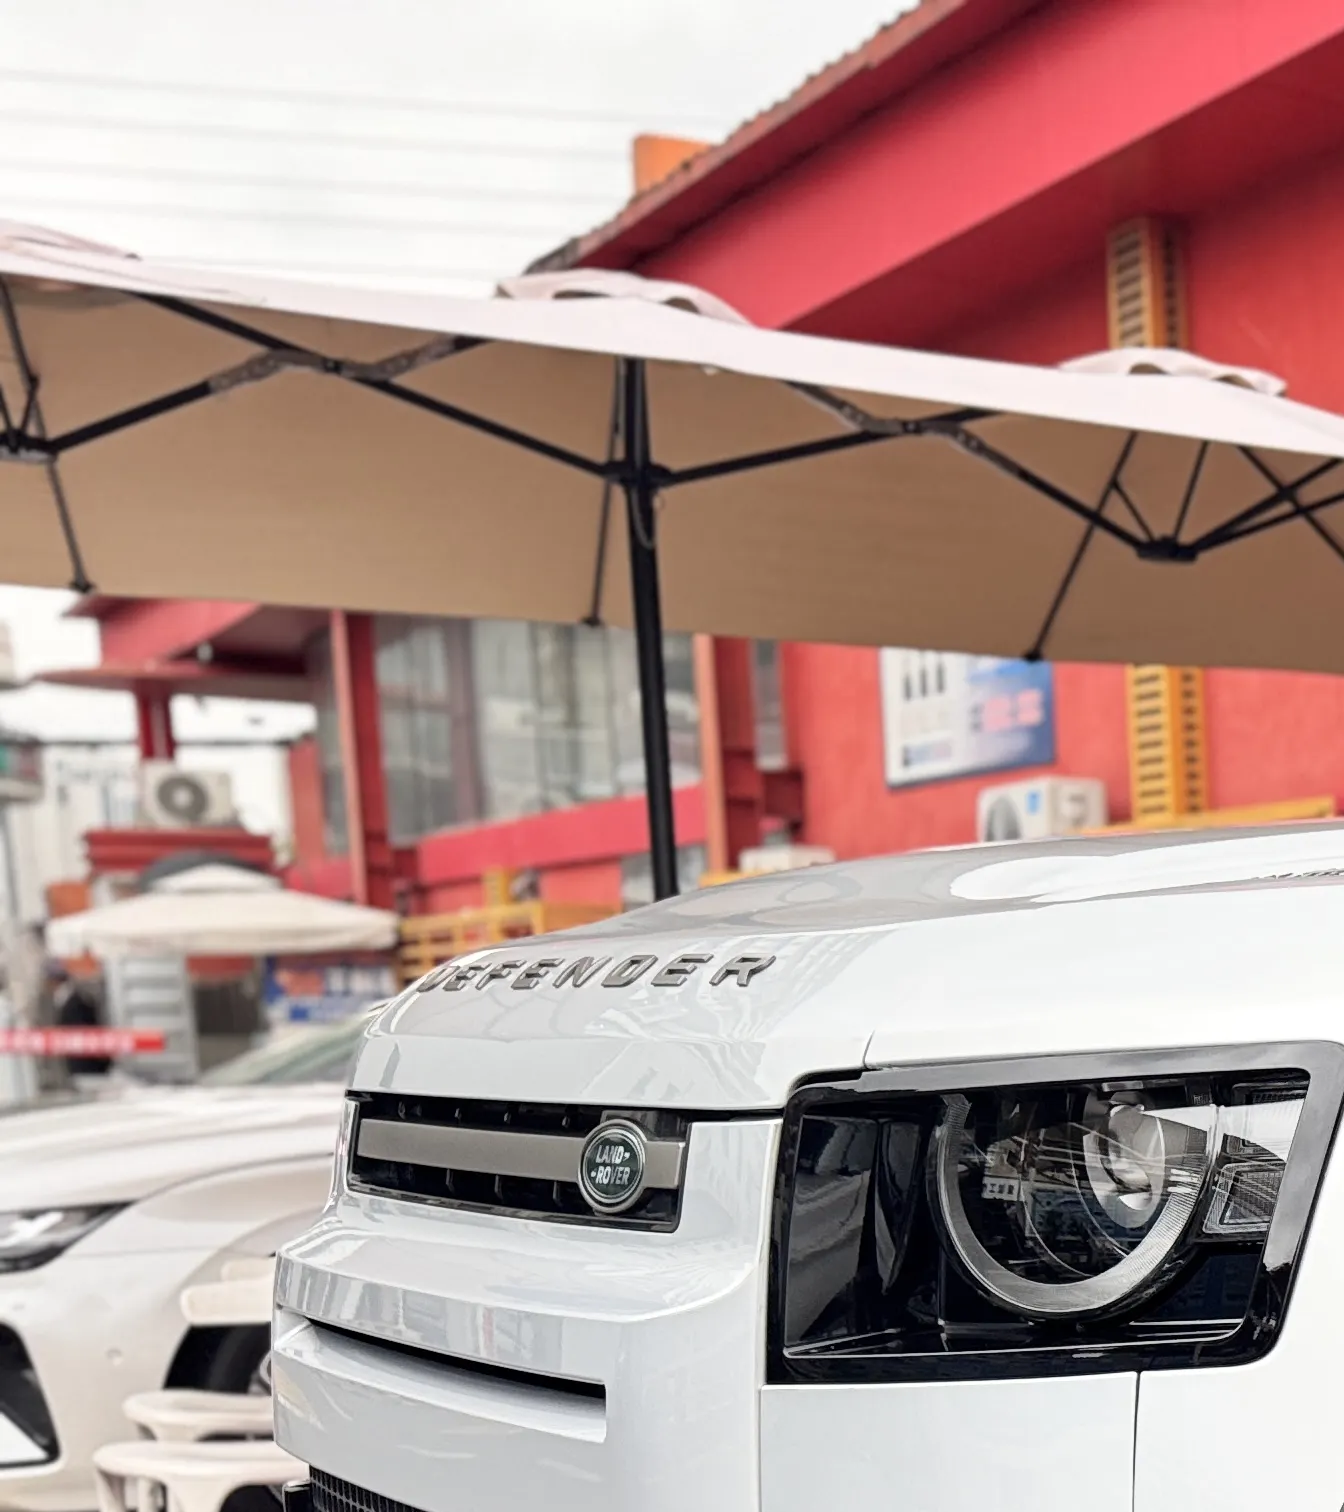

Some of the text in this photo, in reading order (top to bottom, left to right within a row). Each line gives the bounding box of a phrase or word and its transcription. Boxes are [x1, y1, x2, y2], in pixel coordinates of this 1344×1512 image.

[417, 953, 776, 993] DEFENDER
[595, 1144, 625, 1164] LAND
[595, 1165, 631, 1185] ROVER
